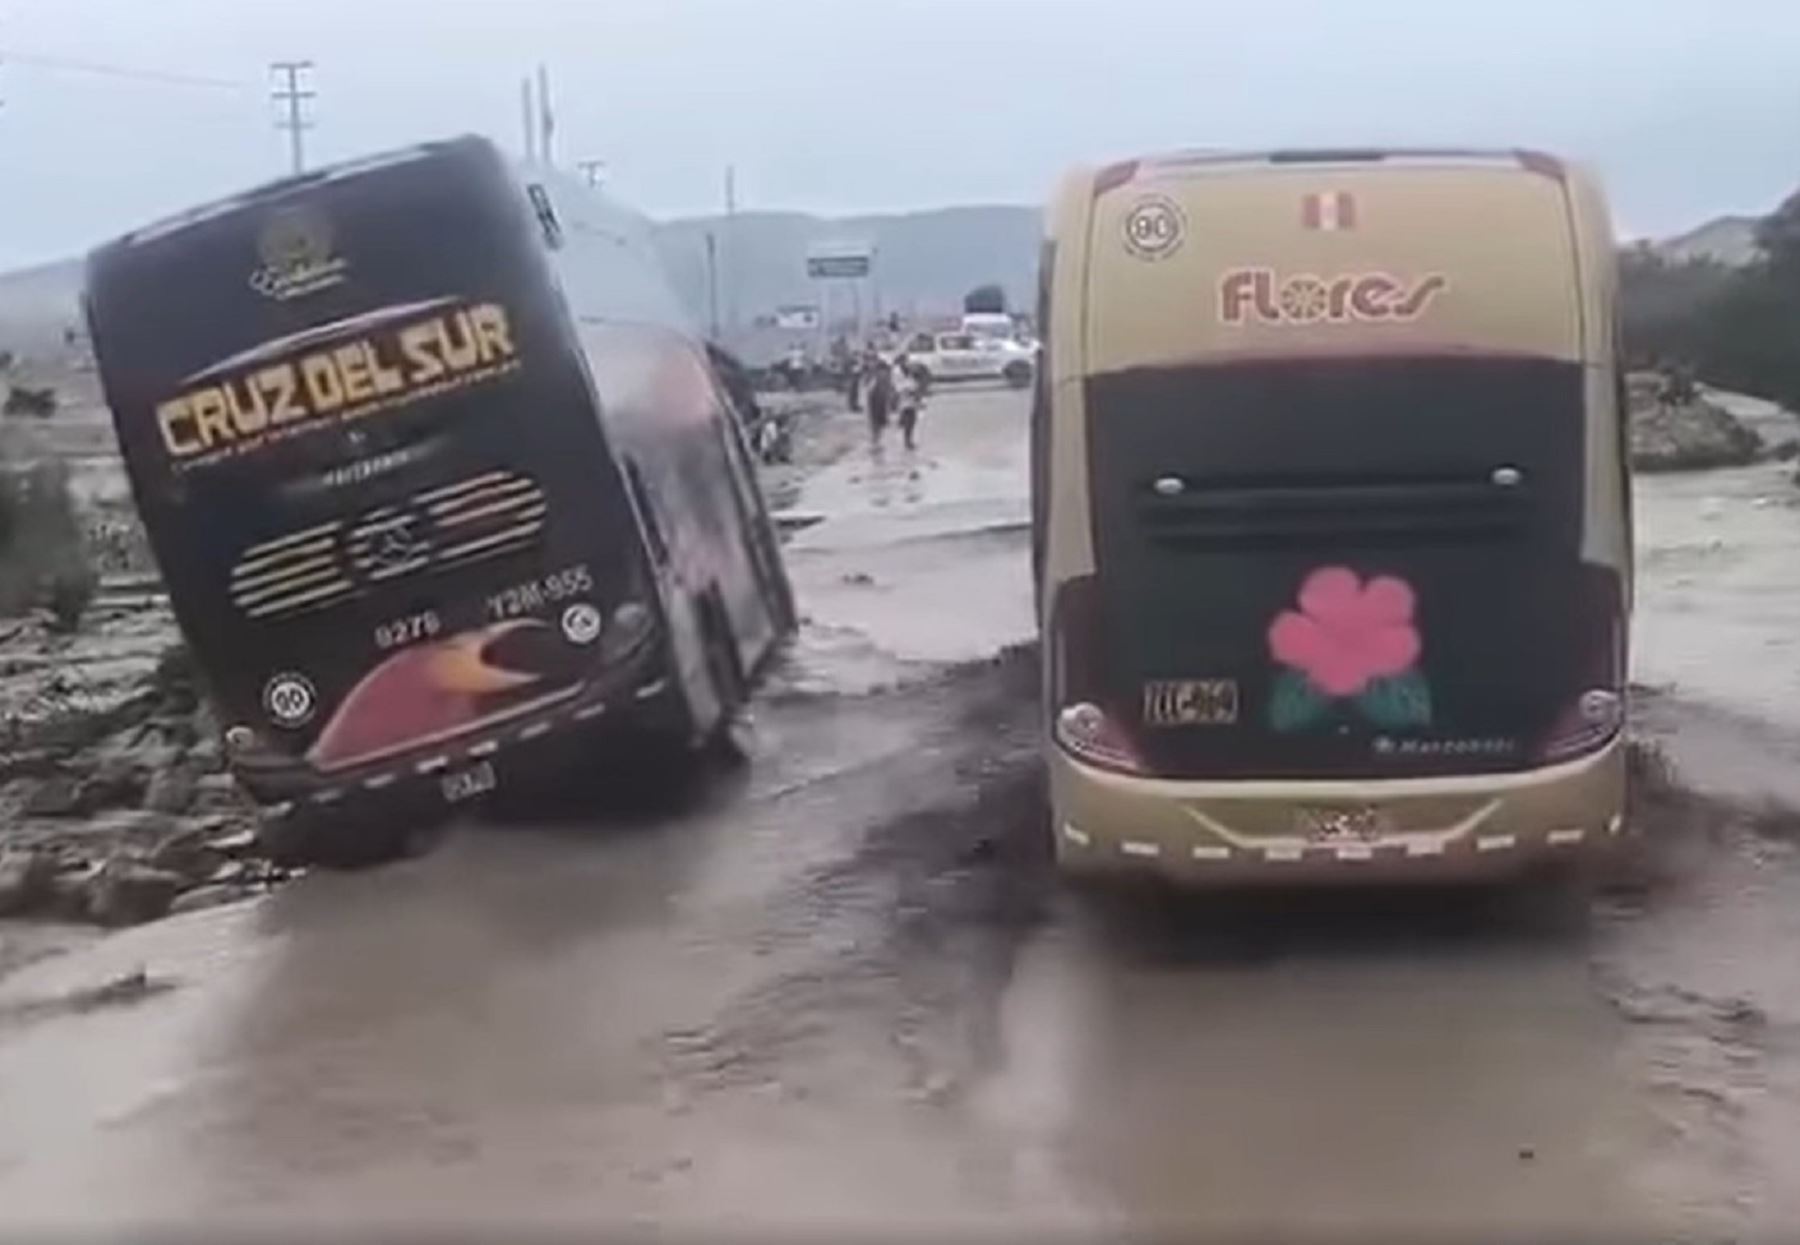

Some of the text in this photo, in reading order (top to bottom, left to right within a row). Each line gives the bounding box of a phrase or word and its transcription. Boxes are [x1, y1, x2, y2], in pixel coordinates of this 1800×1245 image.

[156, 362, 306, 457] CRUZ
[301, 339, 402, 412] DEL
[401, 303, 515, 383] SUR
